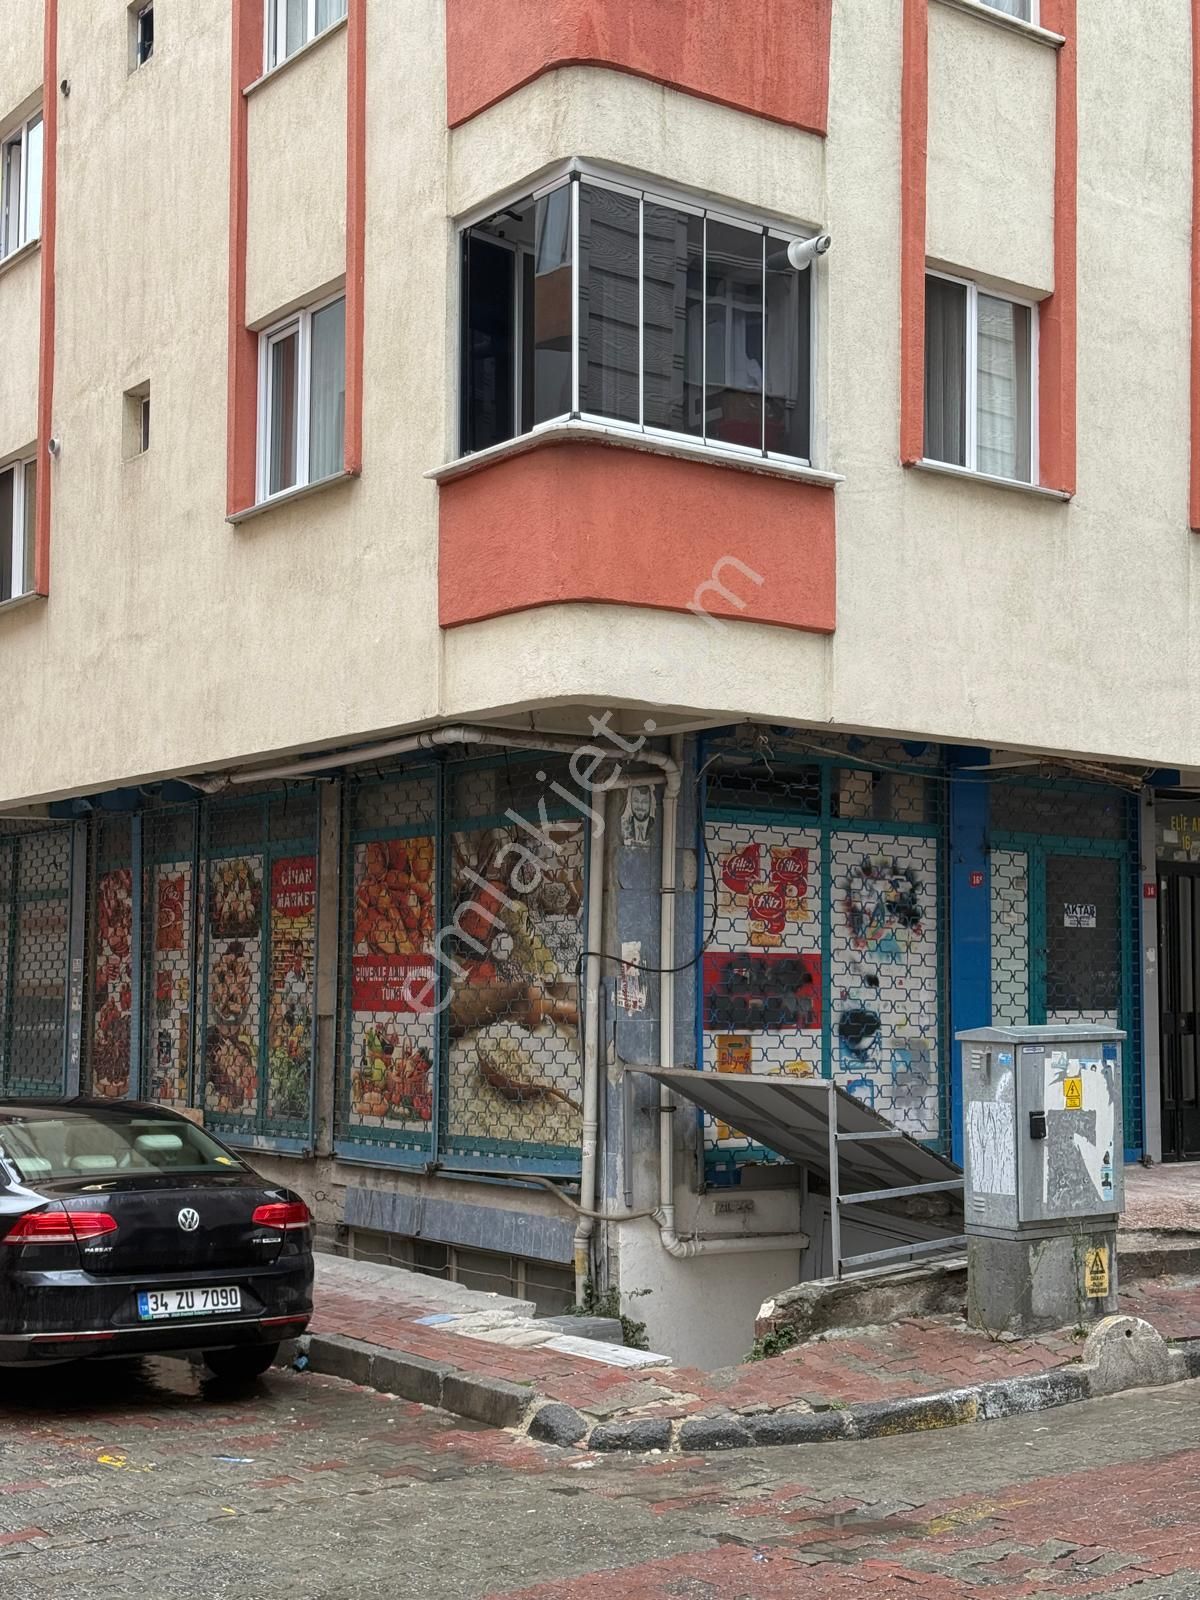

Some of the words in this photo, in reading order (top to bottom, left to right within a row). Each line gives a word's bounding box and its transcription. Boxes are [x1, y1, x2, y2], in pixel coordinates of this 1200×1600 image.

[276, 891, 317, 908] MARKET
[149, 1293, 168, 1312] 34
[176, 1290, 195, 1310] ZU
[201, 1287, 238, 1308] 7090
